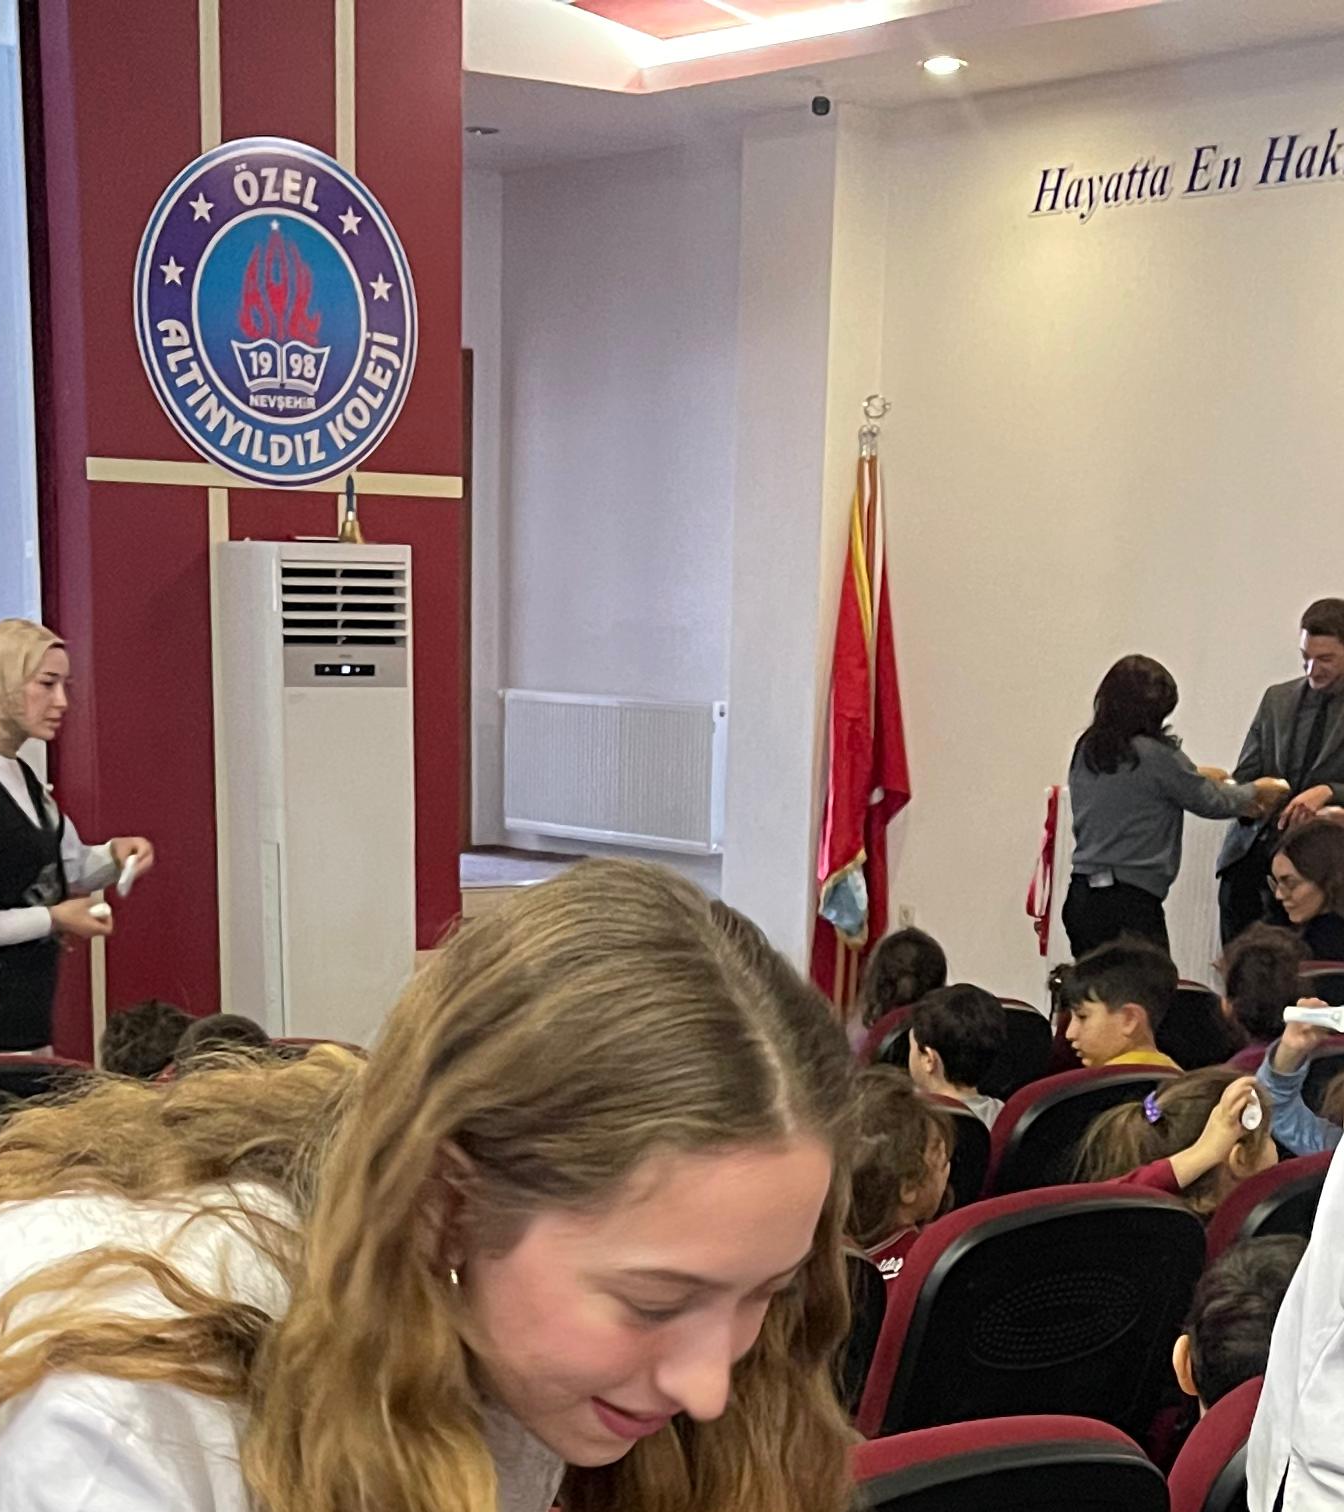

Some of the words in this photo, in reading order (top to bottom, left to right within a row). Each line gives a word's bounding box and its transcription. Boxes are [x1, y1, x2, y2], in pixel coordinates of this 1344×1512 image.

[233, 163, 319, 212] ÖZEL
[1032, 166, 1171, 220] Hayatta
[1183, 144, 1242, 194] En
[157, 319, 326, 466] ALTINYILDIZ
[326, 332, 401, 450] KOLEJİ
[249, 351, 272, 376] 19
[289, 353, 316, 379] 98
